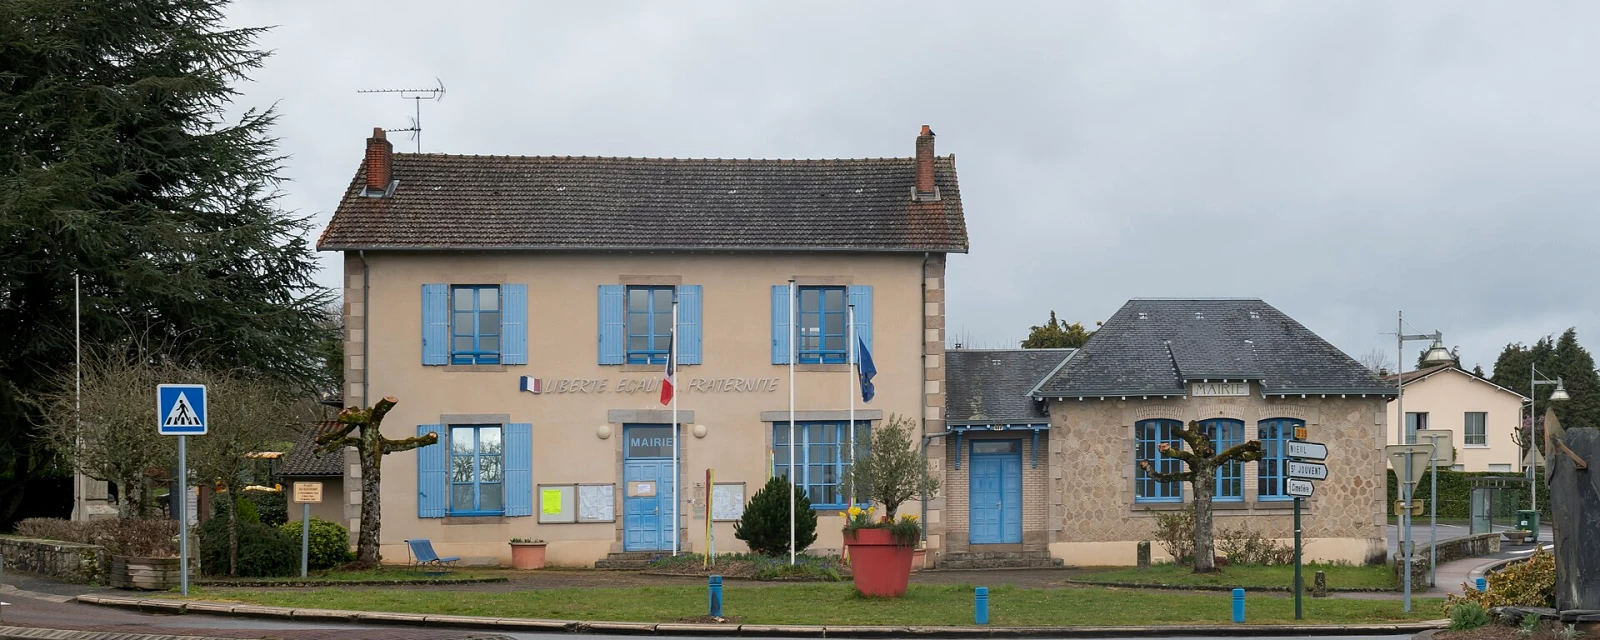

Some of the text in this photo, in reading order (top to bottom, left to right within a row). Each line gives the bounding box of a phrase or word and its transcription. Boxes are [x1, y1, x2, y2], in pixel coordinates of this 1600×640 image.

[545, 377, 779, 395] LIBERTE EGALI FRATERNITE
[1195, 383, 1245, 395] MAIRIE
[631, 437, 673, 447] MAIRIE
[1290, 444, 1307, 455] NIEUL
[1298, 465, 1321, 476] JOUVENT
